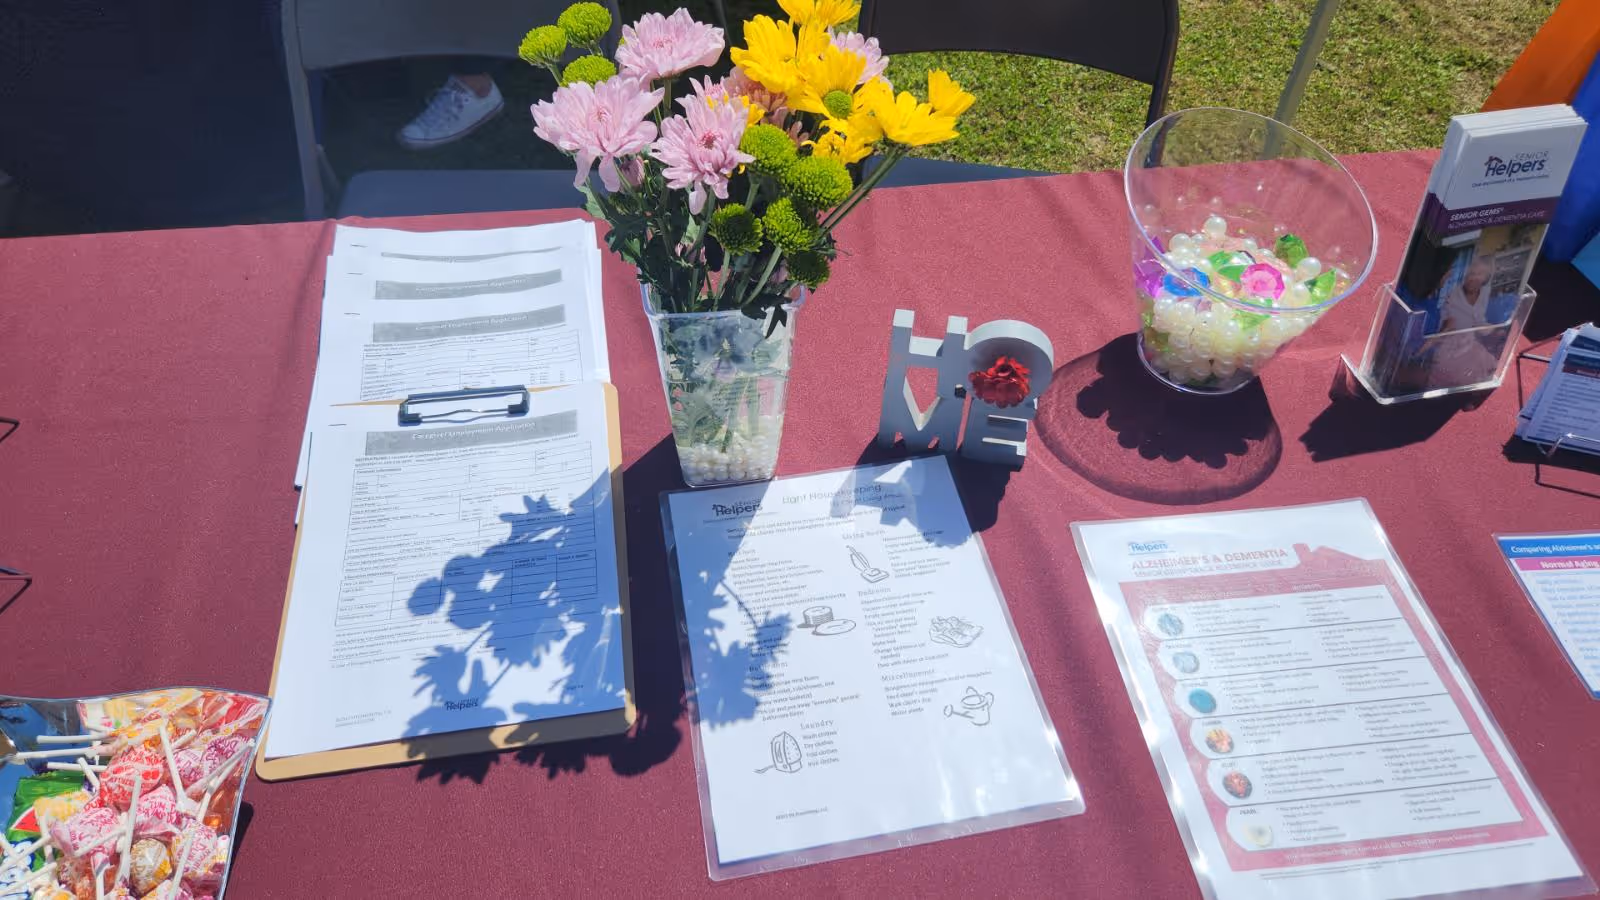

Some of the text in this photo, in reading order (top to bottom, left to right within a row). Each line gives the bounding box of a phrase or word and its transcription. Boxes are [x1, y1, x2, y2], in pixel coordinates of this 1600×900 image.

[1514, 150, 1549, 161] SENIOR
[1485, 158, 1546, 177] Helpers
[1450, 210, 1478, 222] SENIOR
[495, 421, 536, 434] Application
[715, 503, 763, 517] Helpers
[1224, 548, 1289, 562] DEMENTIA
[1540, 560, 1574, 569] Normal
[445, 698, 480, 712] Helpers
[800, 719, 835, 731] Laundry
